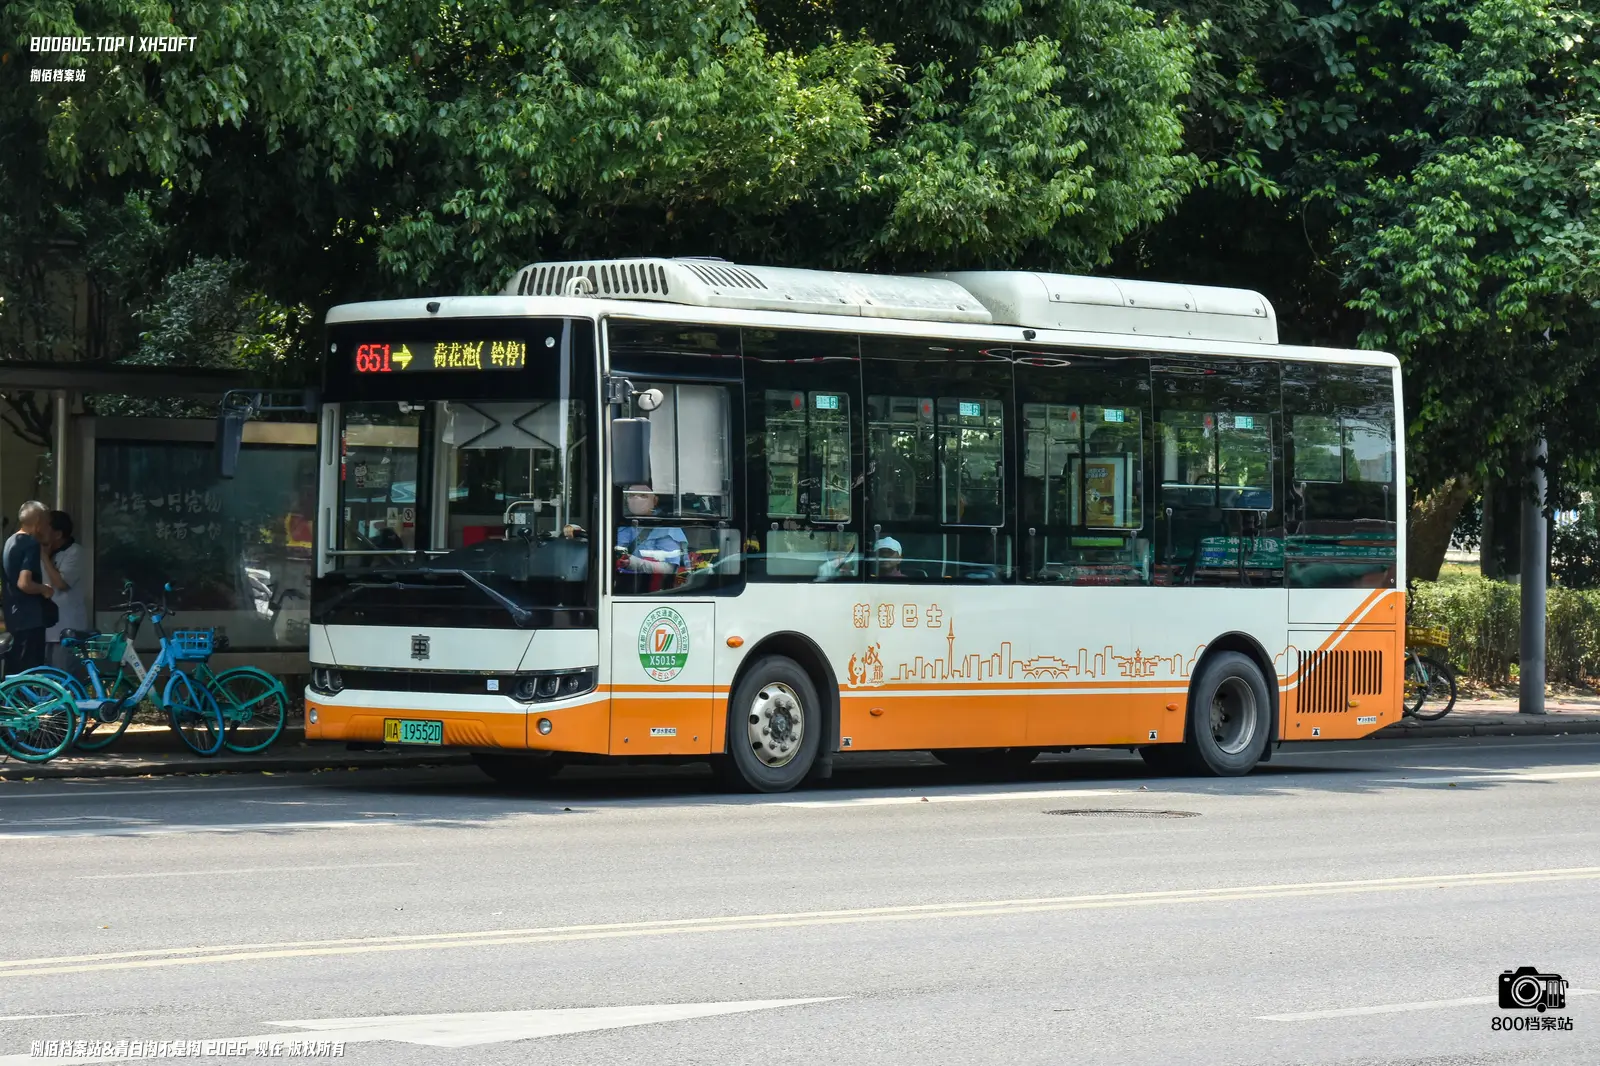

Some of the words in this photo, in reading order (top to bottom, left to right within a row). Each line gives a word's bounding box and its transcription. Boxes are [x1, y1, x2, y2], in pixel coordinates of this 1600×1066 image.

[356, 344, 392, 372] 651
[853, 603, 943, 629] 新都巴士
[649, 655, 676, 666] X5015
